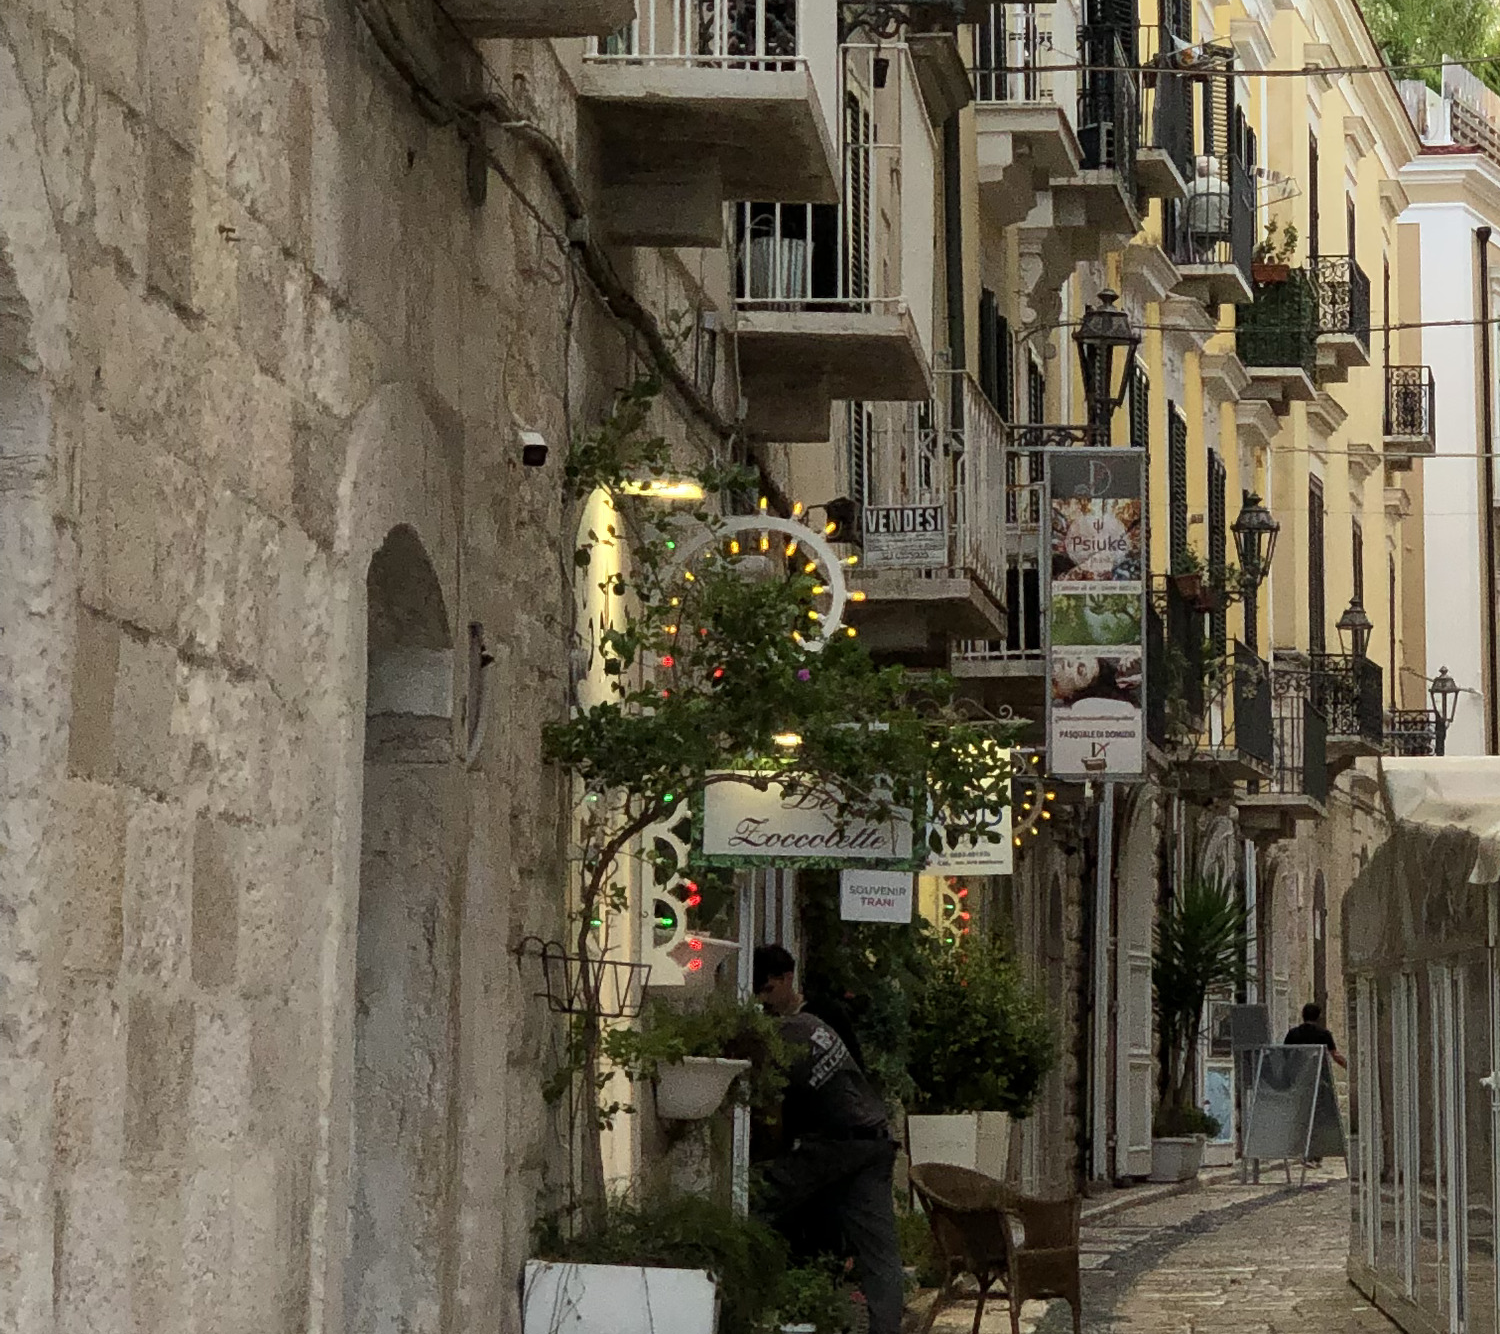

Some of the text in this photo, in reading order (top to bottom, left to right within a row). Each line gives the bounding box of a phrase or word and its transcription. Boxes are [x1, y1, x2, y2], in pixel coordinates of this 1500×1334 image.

[866, 508, 942, 533] VENDESI
[849, 885, 907, 896] SOUVENIR
[860, 897, 895, 907] TRANI
